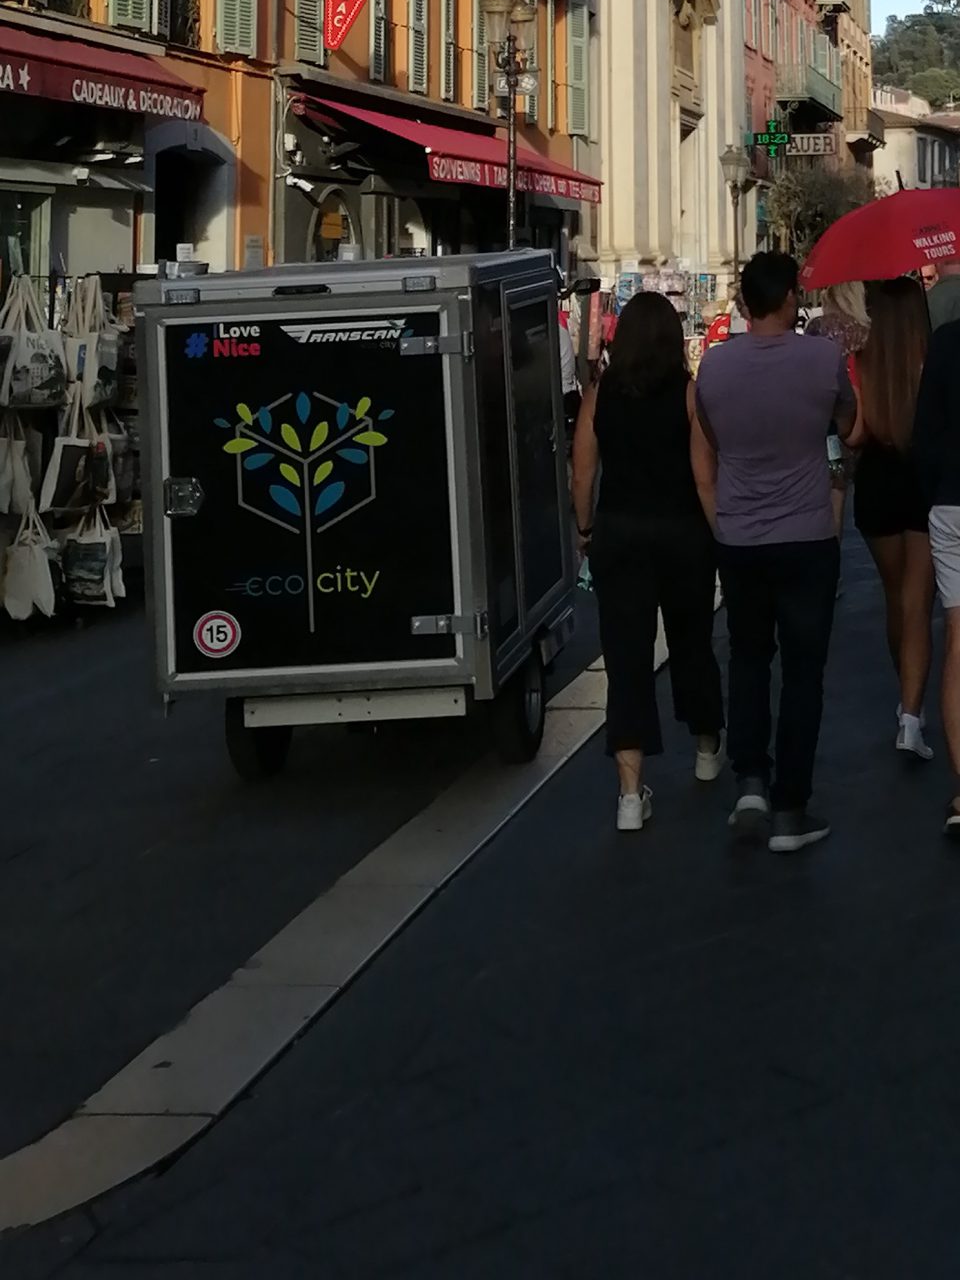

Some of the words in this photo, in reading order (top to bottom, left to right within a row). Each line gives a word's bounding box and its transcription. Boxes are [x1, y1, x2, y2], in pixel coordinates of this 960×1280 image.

[72, 79, 125, 108] CADEAUX
[127, 89, 137, 111] &
[788, 135, 833, 153] AUER
[912, 231, 957, 249] WALKING
[923, 244, 956, 260] TOURS
[213, 339, 261, 358] Nice
[246, 575, 305, 597] eco
[316, 564, 380, 599] city
[206, 624, 228, 644] 15
